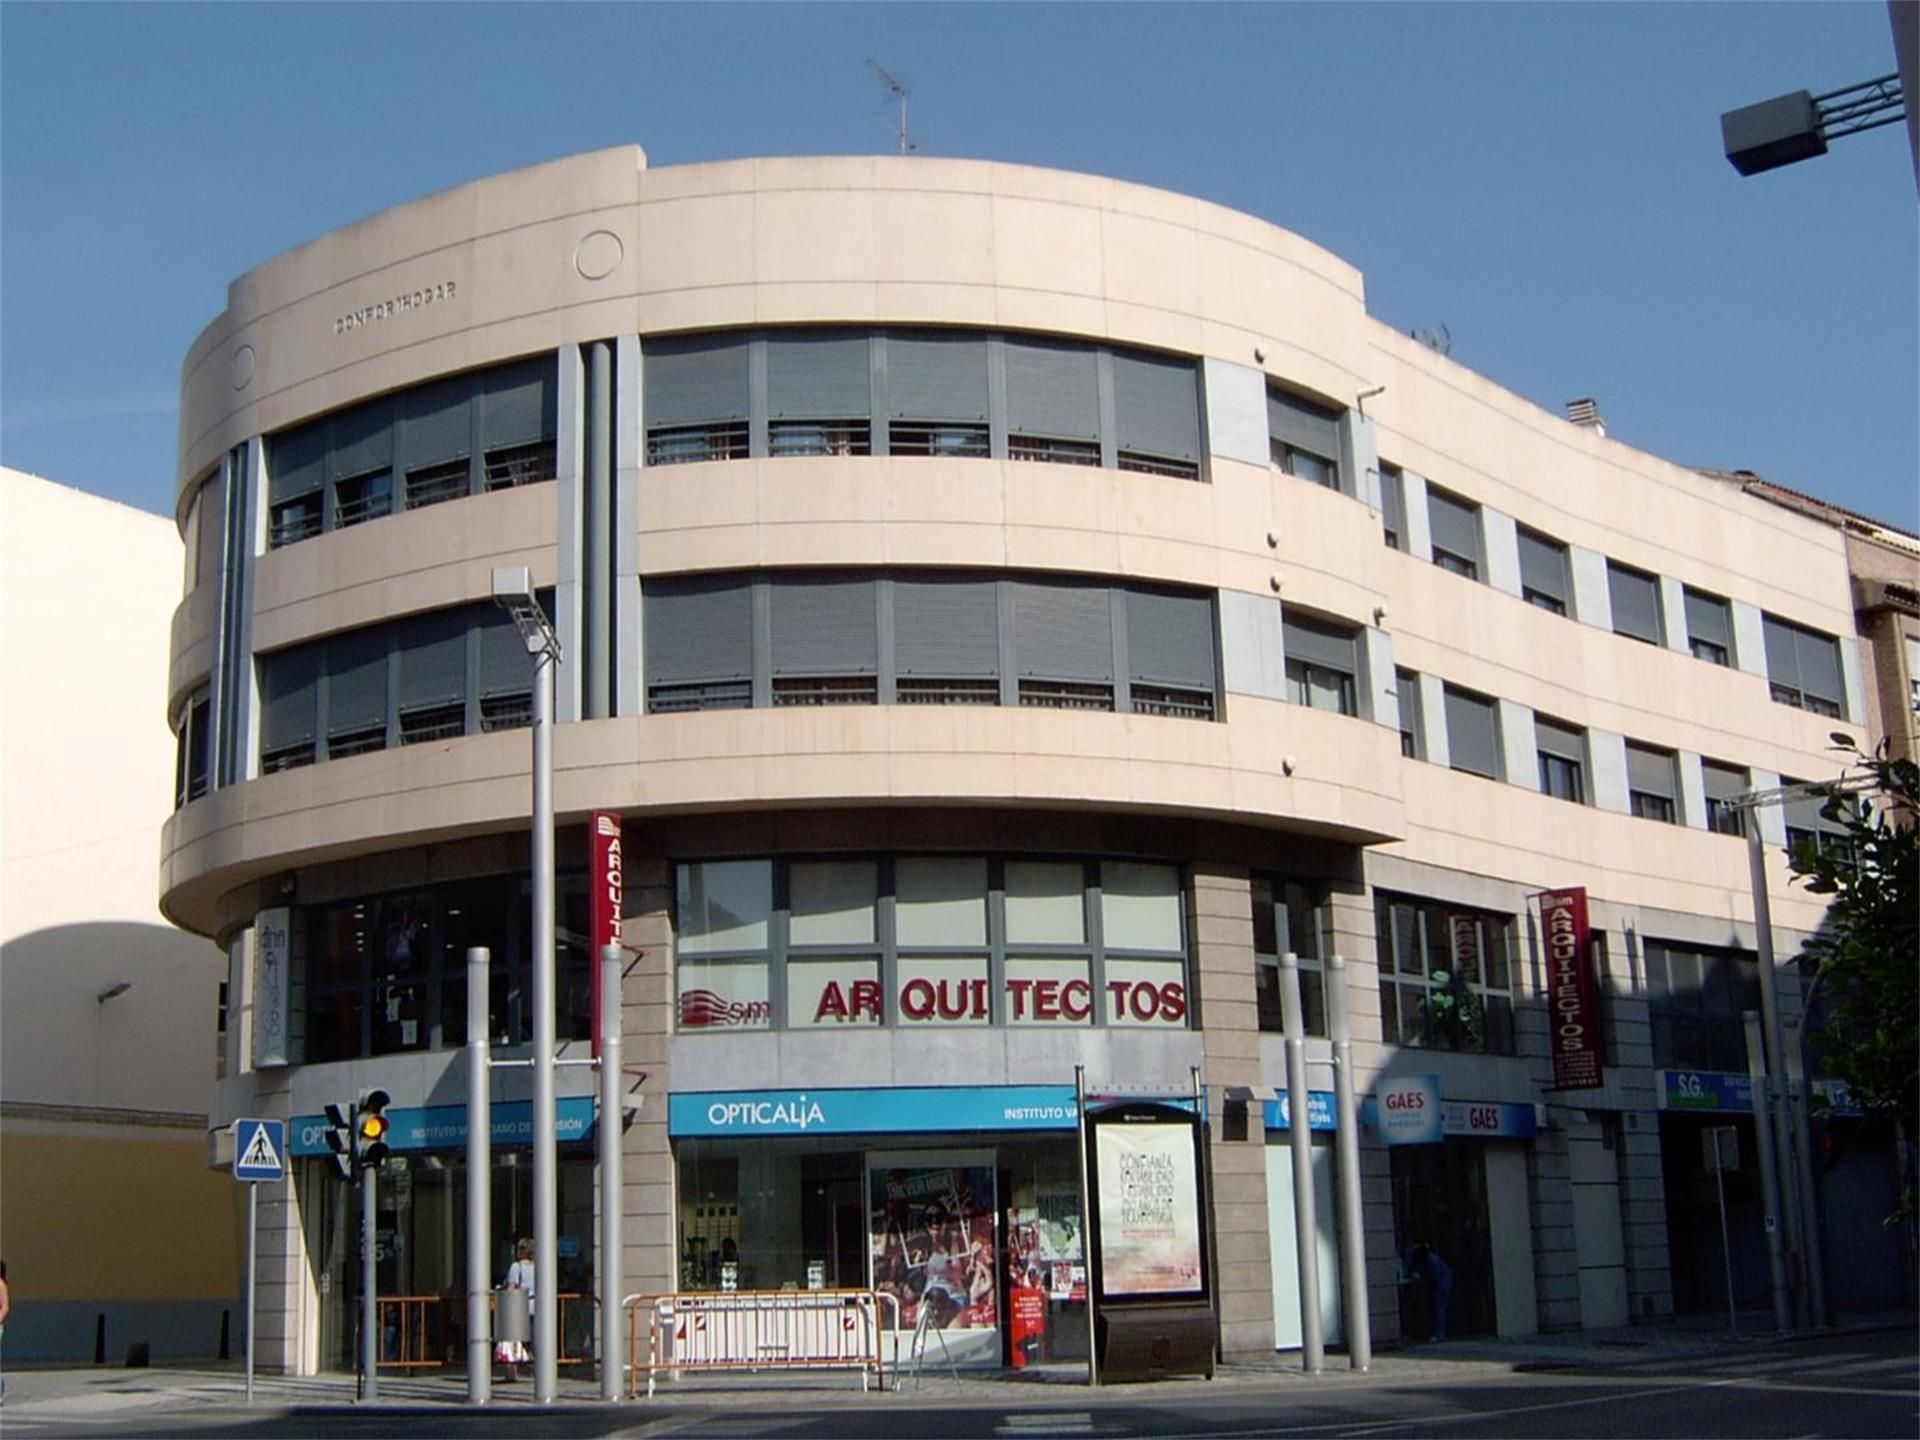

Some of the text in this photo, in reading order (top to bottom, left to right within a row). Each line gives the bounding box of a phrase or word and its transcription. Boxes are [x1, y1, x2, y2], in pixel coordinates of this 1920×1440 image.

[1551, 908, 1584, 1050] ARQUITECTOS
[1386, 1092, 1424, 1110] GAES
[1004, 1107, 1063, 1121] INSTITUTO
[1470, 1107, 1499, 1130] GAES
